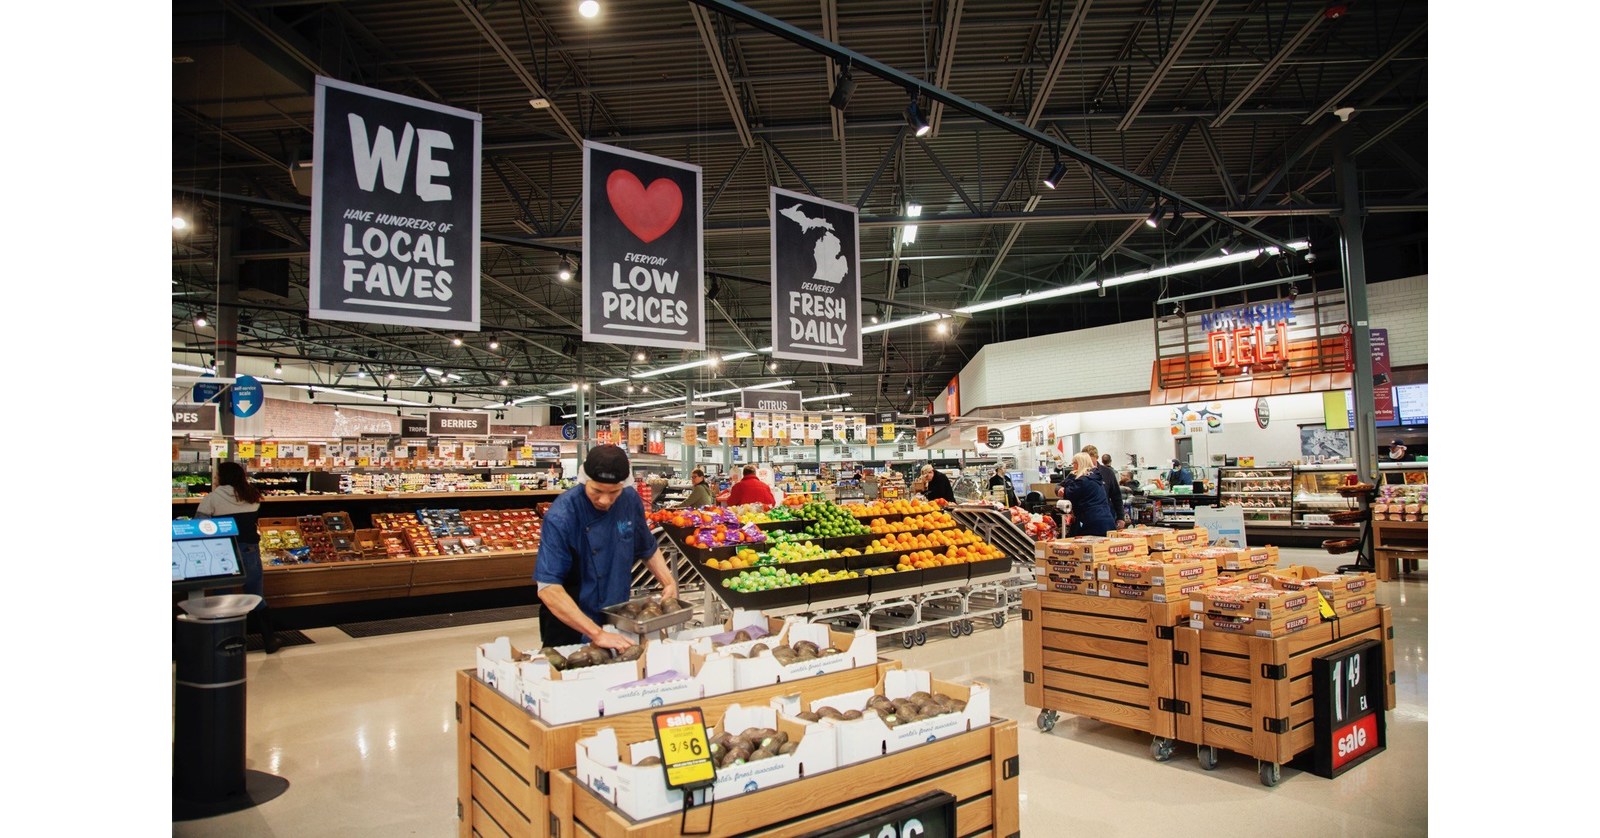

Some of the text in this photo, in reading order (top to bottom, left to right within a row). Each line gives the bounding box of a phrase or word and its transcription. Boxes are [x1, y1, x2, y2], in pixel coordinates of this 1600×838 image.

[348, 113, 454, 202] WE
[344, 208, 453, 233] HAVE HUNDREDS OF
[344, 223, 455, 267] LOCAL
[624, 252, 668, 267] EVERYDAY
[343, 259, 453, 302] FAVES
[612, 262, 680, 295] LOW
[801, 281, 836, 294] DELIVERED
[602, 291, 689, 326] PRICES
[788, 291, 847, 320] FRESH
[1201, 300, 1297, 331] NORTHSIDE
[788, 317, 848, 346] DAILY
[1208, 322, 1289, 368] DELI
[758, 400, 788, 411] CITRUS
[441, 419, 478, 429] BERRIES
[1109, 545, 1133, 553] WELLPICT
[1180, 568, 1203, 576] WELLPICT
[1285, 597, 1306, 608] WELLPICT
[1286, 618, 1307, 628] WELLPICT
[1348, 653, 1360, 688] 49
[1360, 695, 1368, 711] EA
[666, 712, 694, 727] sale
[1338, 725, 1366, 757] sale
[734, 769, 753, 781] finest
